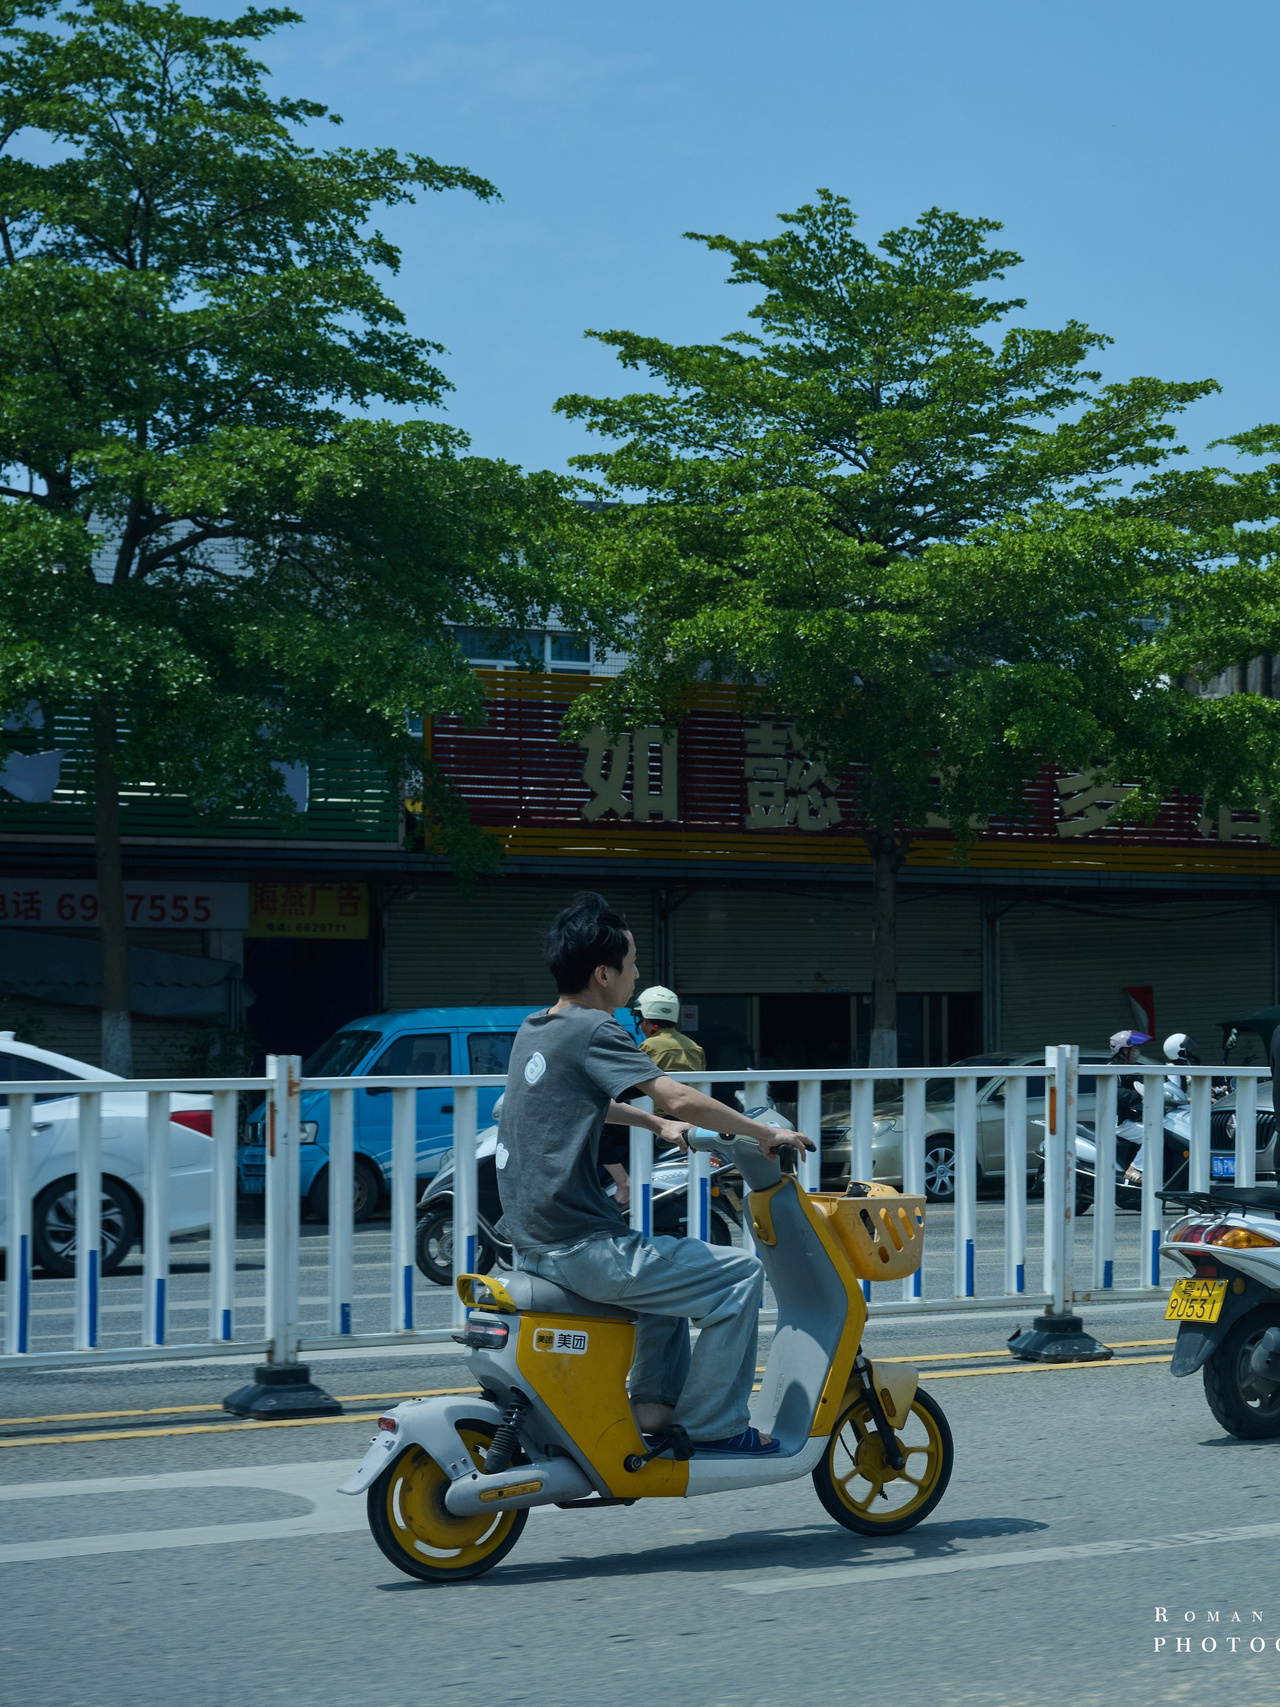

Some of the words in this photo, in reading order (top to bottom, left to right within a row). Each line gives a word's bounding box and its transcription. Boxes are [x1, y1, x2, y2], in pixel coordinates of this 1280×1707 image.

[57, 893, 212, 922] 697555
[1169, 1298, 1216, 1320] 9U531
[557, 1333, 586, 1350] 美团
